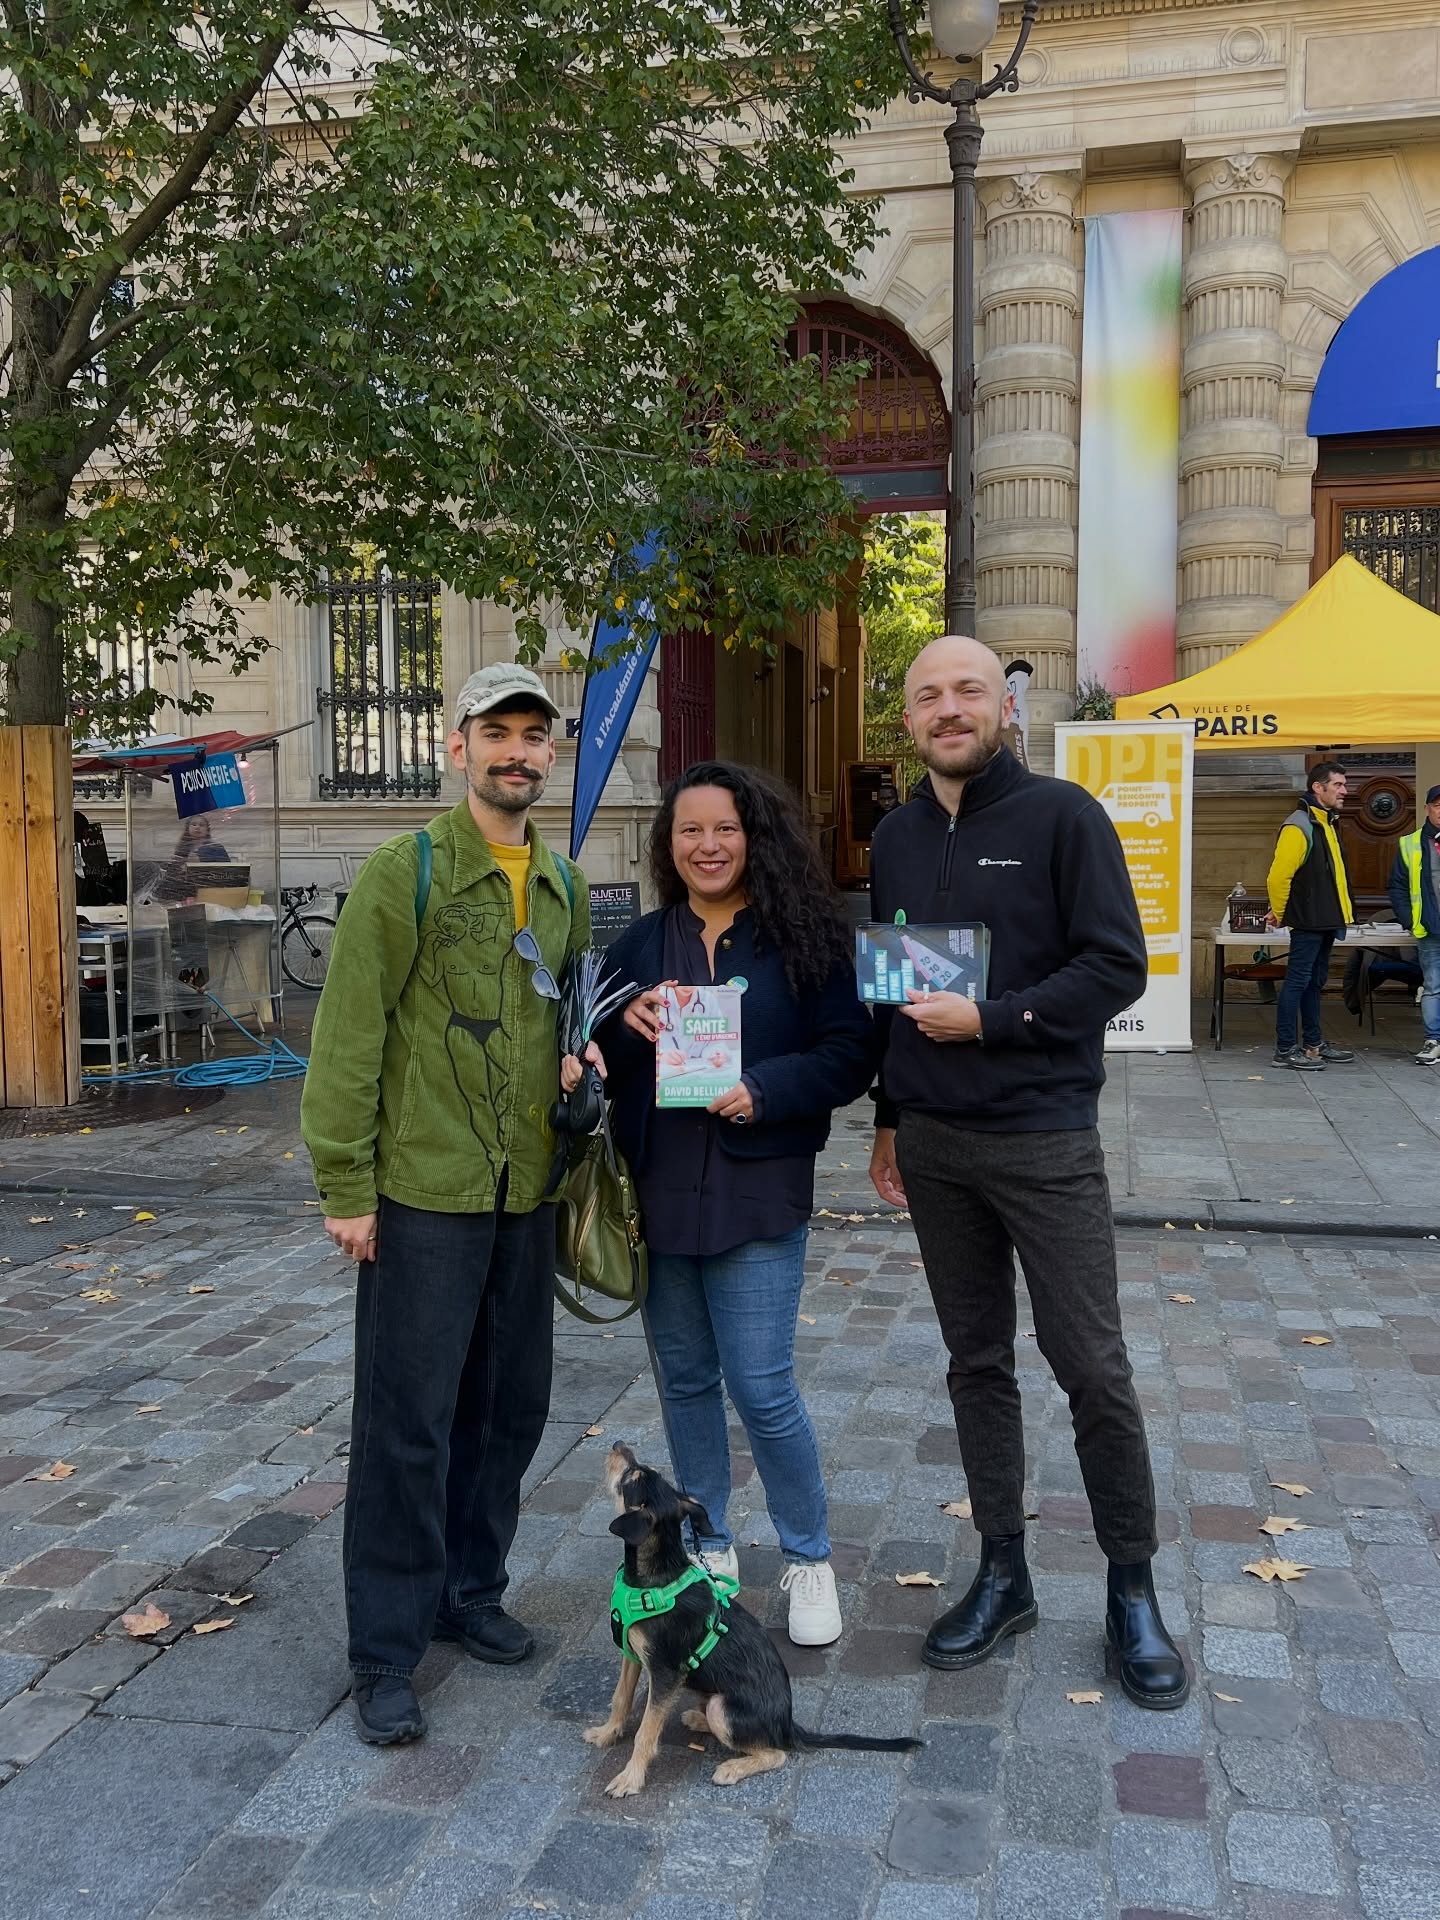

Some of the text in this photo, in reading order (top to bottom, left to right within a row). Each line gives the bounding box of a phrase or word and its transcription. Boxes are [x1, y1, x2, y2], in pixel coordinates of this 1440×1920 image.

[1193, 705, 1229, 714] VILLE
[1194, 714, 1278, 738] PARIS
[590, 888, 632, 898] BUVETTE
[940, 970, 952, 983] 20
[1106, 1019, 1145, 1032] ARIS
[664, 1086, 692, 1097] DAVID
